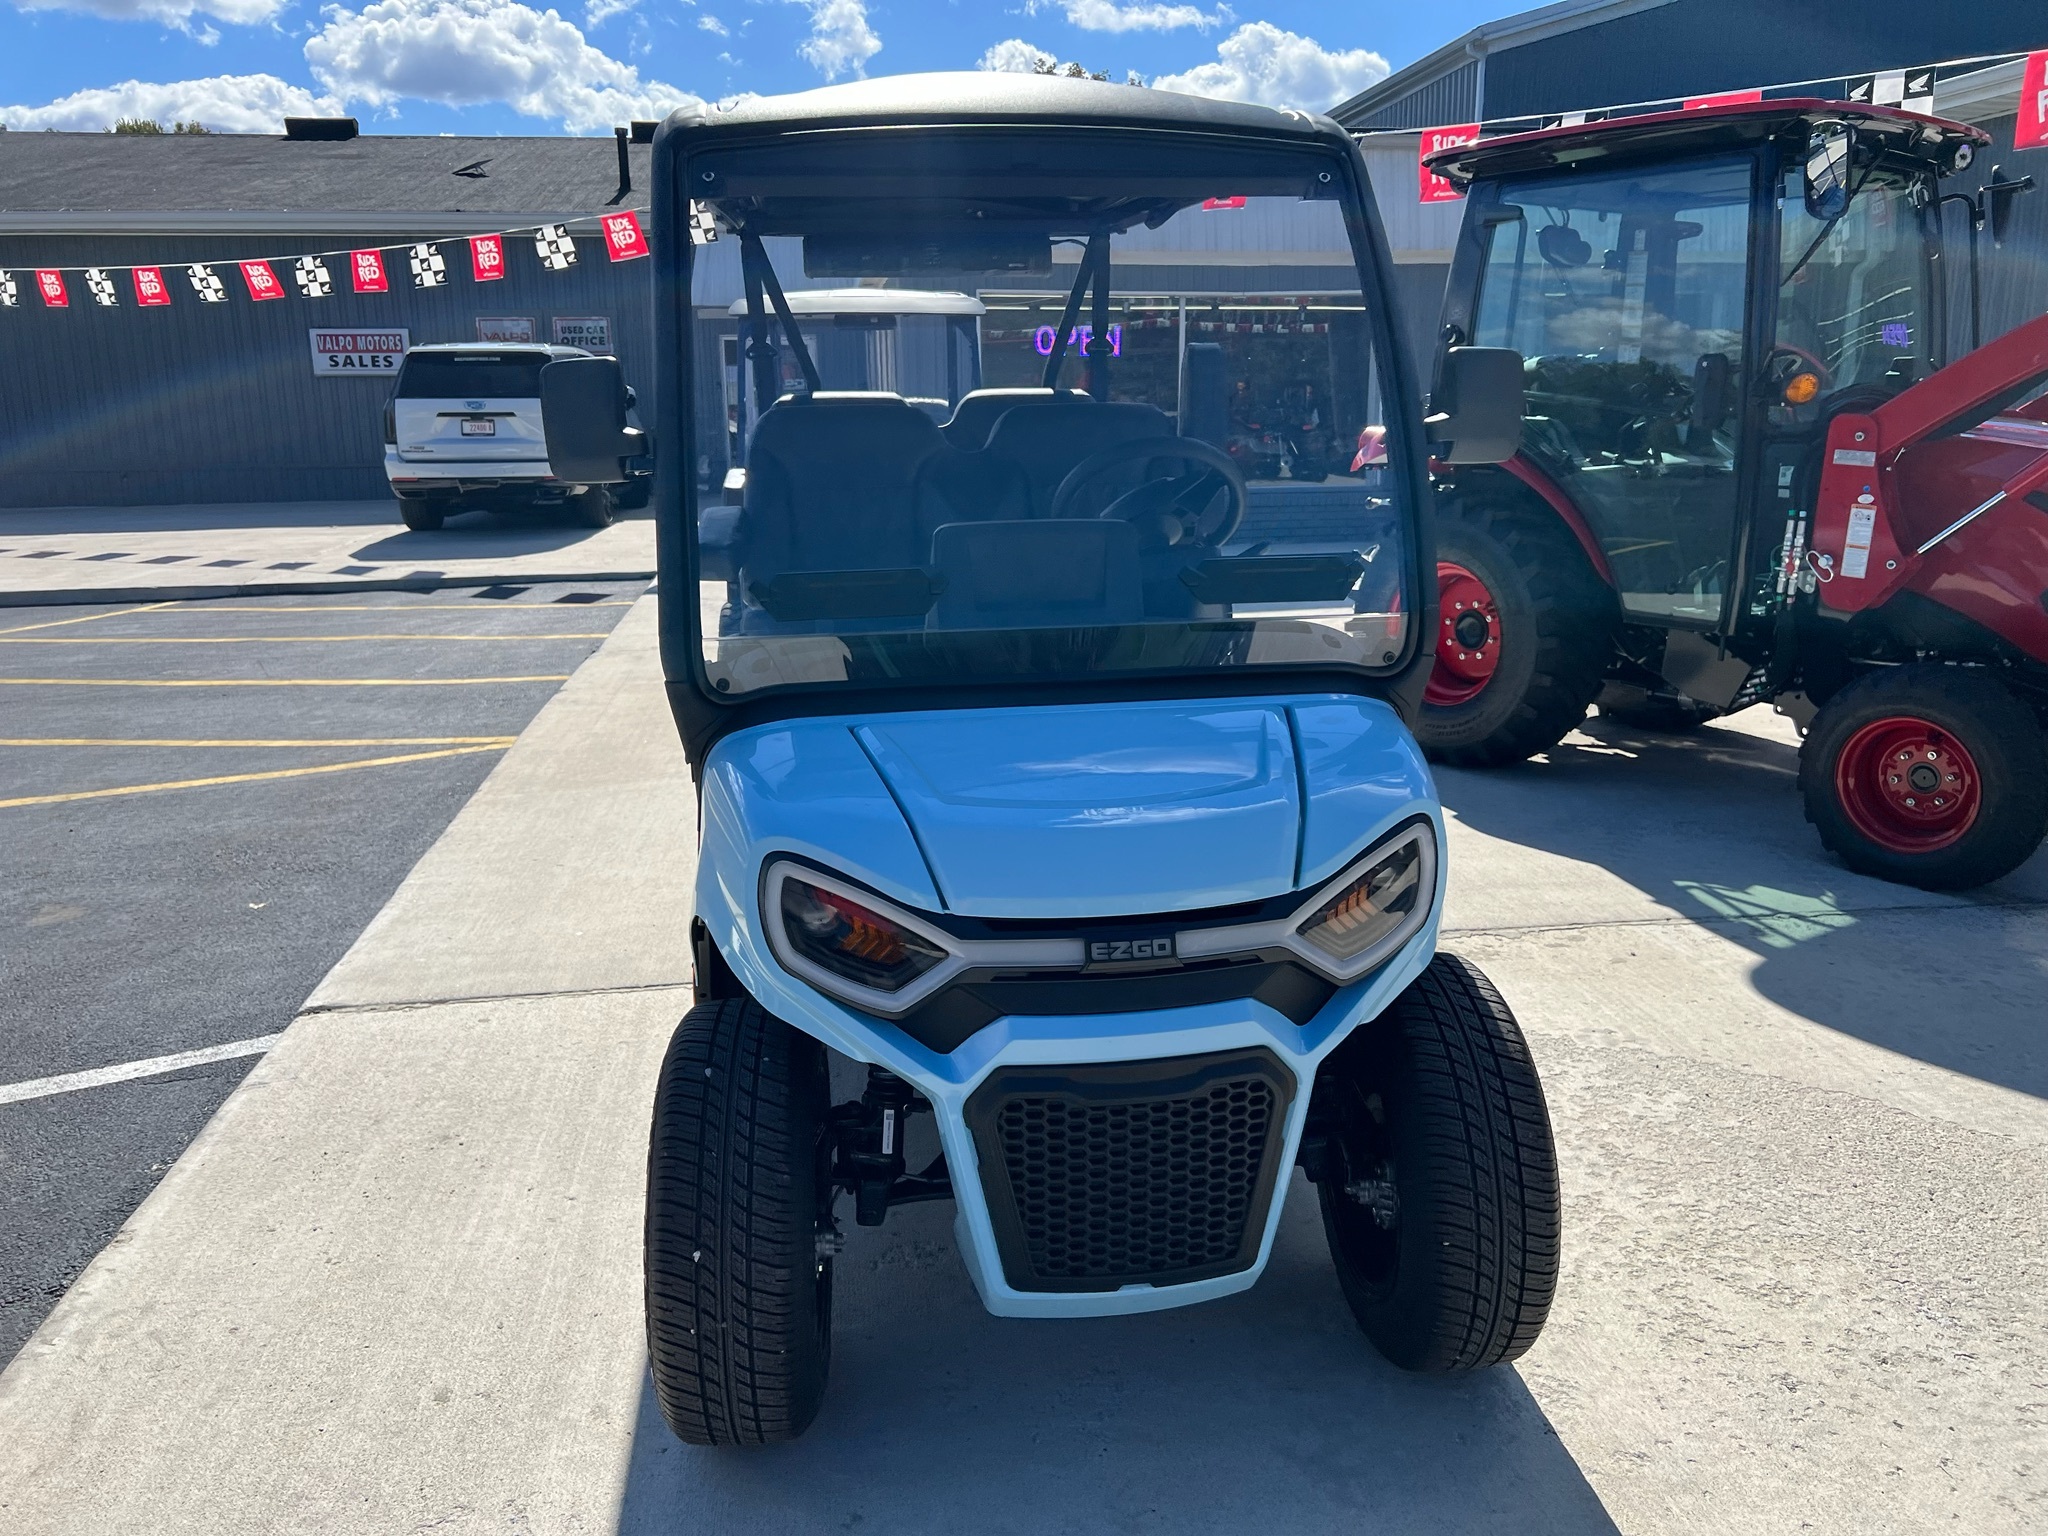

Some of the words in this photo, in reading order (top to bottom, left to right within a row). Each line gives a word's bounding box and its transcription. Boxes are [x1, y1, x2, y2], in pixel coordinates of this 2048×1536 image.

[607, 217, 633, 232] RIDE
[475, 239, 498, 253] RIDE
[611, 230, 637, 249] RED
[356, 253, 378, 267] RIDE
[477, 252, 500, 270] RED
[137, 270, 158, 282] RIDE
[245, 264, 269, 277] RIDE
[358, 266, 380, 282] RED
[40, 272, 59, 285] RIDE
[250, 275, 273, 291] RED
[43, 284, 61, 298] RED
[140, 281, 160, 297] RED
[483, 332, 530, 342] VALPO
[561, 326, 584, 335] USED
[586, 325, 605, 335] CAR
[317, 335, 353, 351] VALPO
[356, 335, 402, 351] MOTORS
[560, 336, 606, 346] OFFICE
[328, 354, 394, 368] SALES
